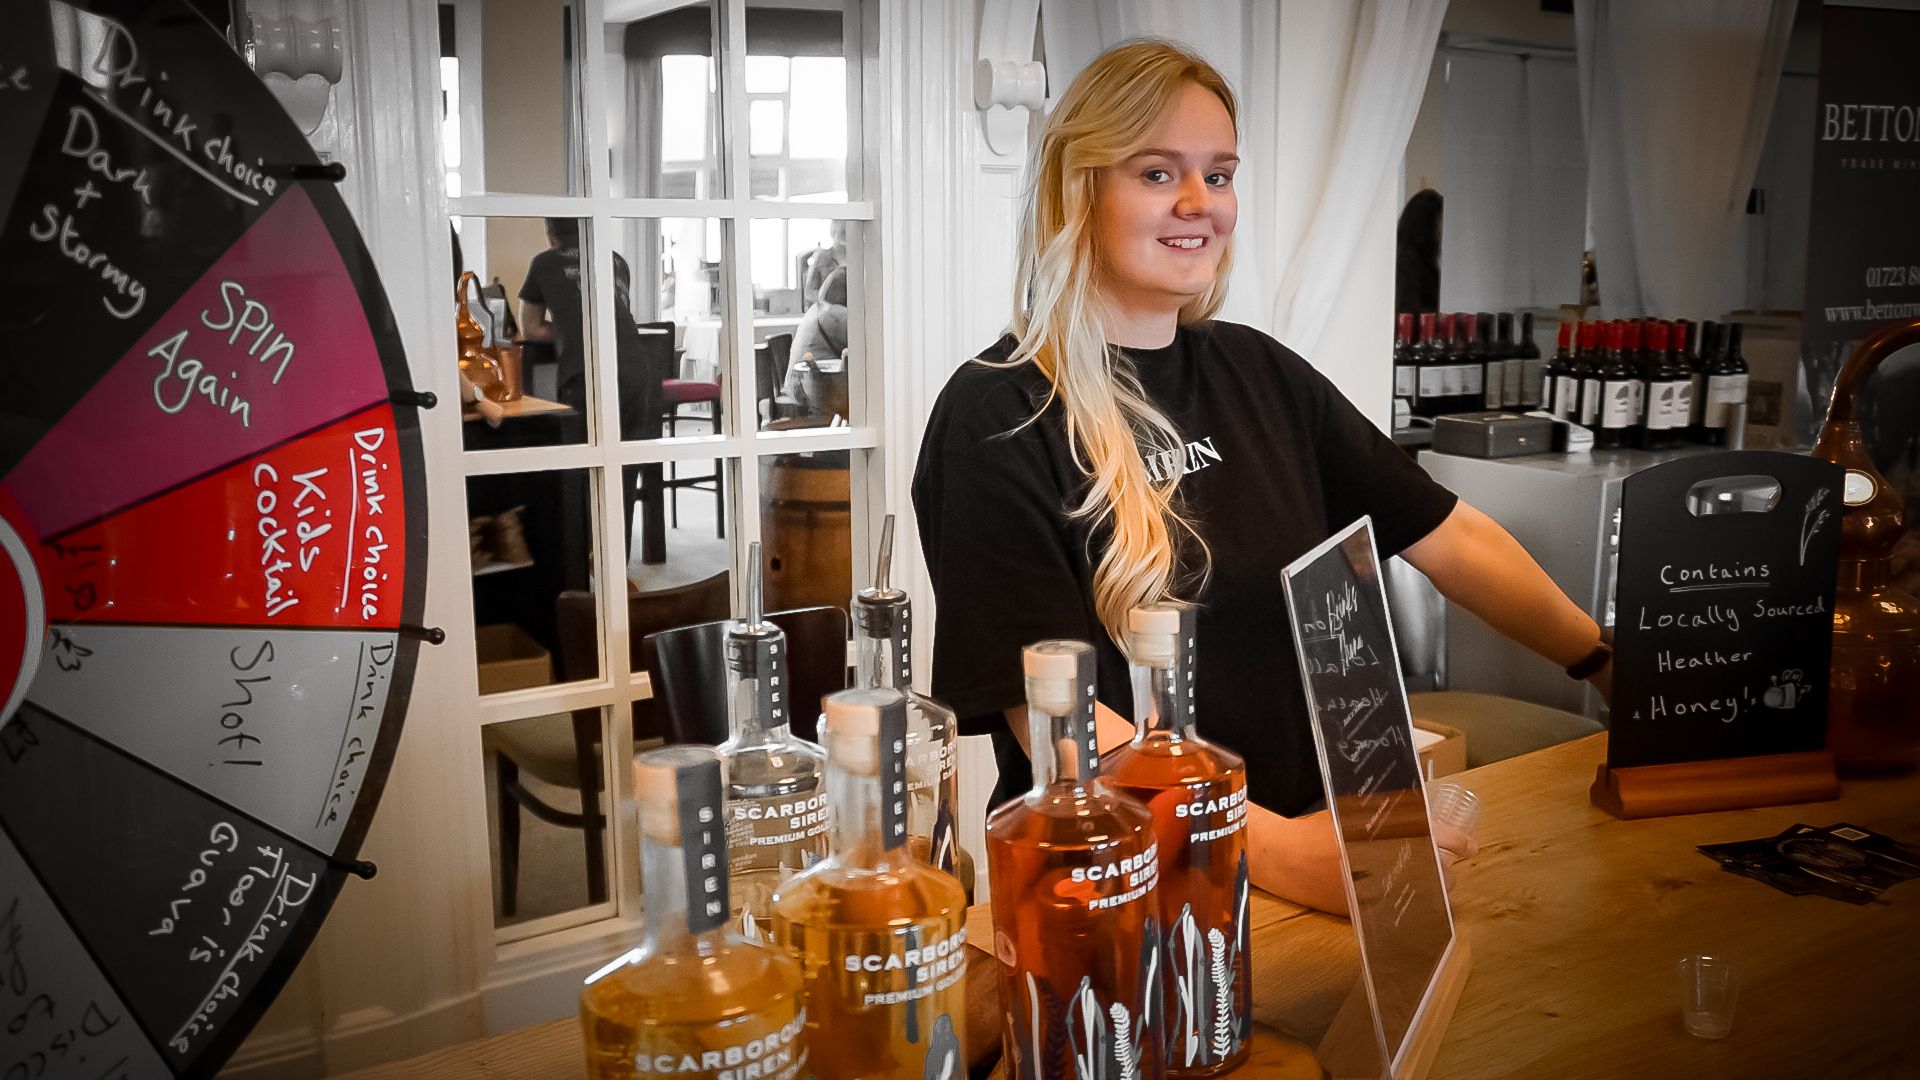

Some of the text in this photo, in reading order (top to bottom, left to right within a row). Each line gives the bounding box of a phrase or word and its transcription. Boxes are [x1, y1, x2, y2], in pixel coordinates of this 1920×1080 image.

[93, 17, 197, 151] Drink
[62, 106, 152, 205] Dark
[74, 181, 101, 208] +
[30, 205, 146, 319] Stormy
[1866, 266, 1906, 288] 01723
[147, 330, 252, 427] Again
[291, 467, 333, 573] Kids
[354, 427, 389, 620] Drink choice
[1639, 596, 1826, 632] Locally Sourced
[1660, 561, 1771, 585] Contains
[769, 644, 782, 719] SIREN
[901, 609, 910, 678] SIREN
[1657, 650, 1752, 673] Heather
[323, 640, 395, 827] Drink choice
[699, 806, 722, 918] SIREN
[749, 830, 806, 846] PREMIUM
[1190, 821, 1240, 844] PREMIUM
[149, 821, 239, 936] Guava
[189, 847, 283, 963] Floor is
[1088, 884, 1147, 911] PREMIUM
[176, 872, 317, 1054] Drink choice
[863, 985, 934, 1008] PREMIUM
